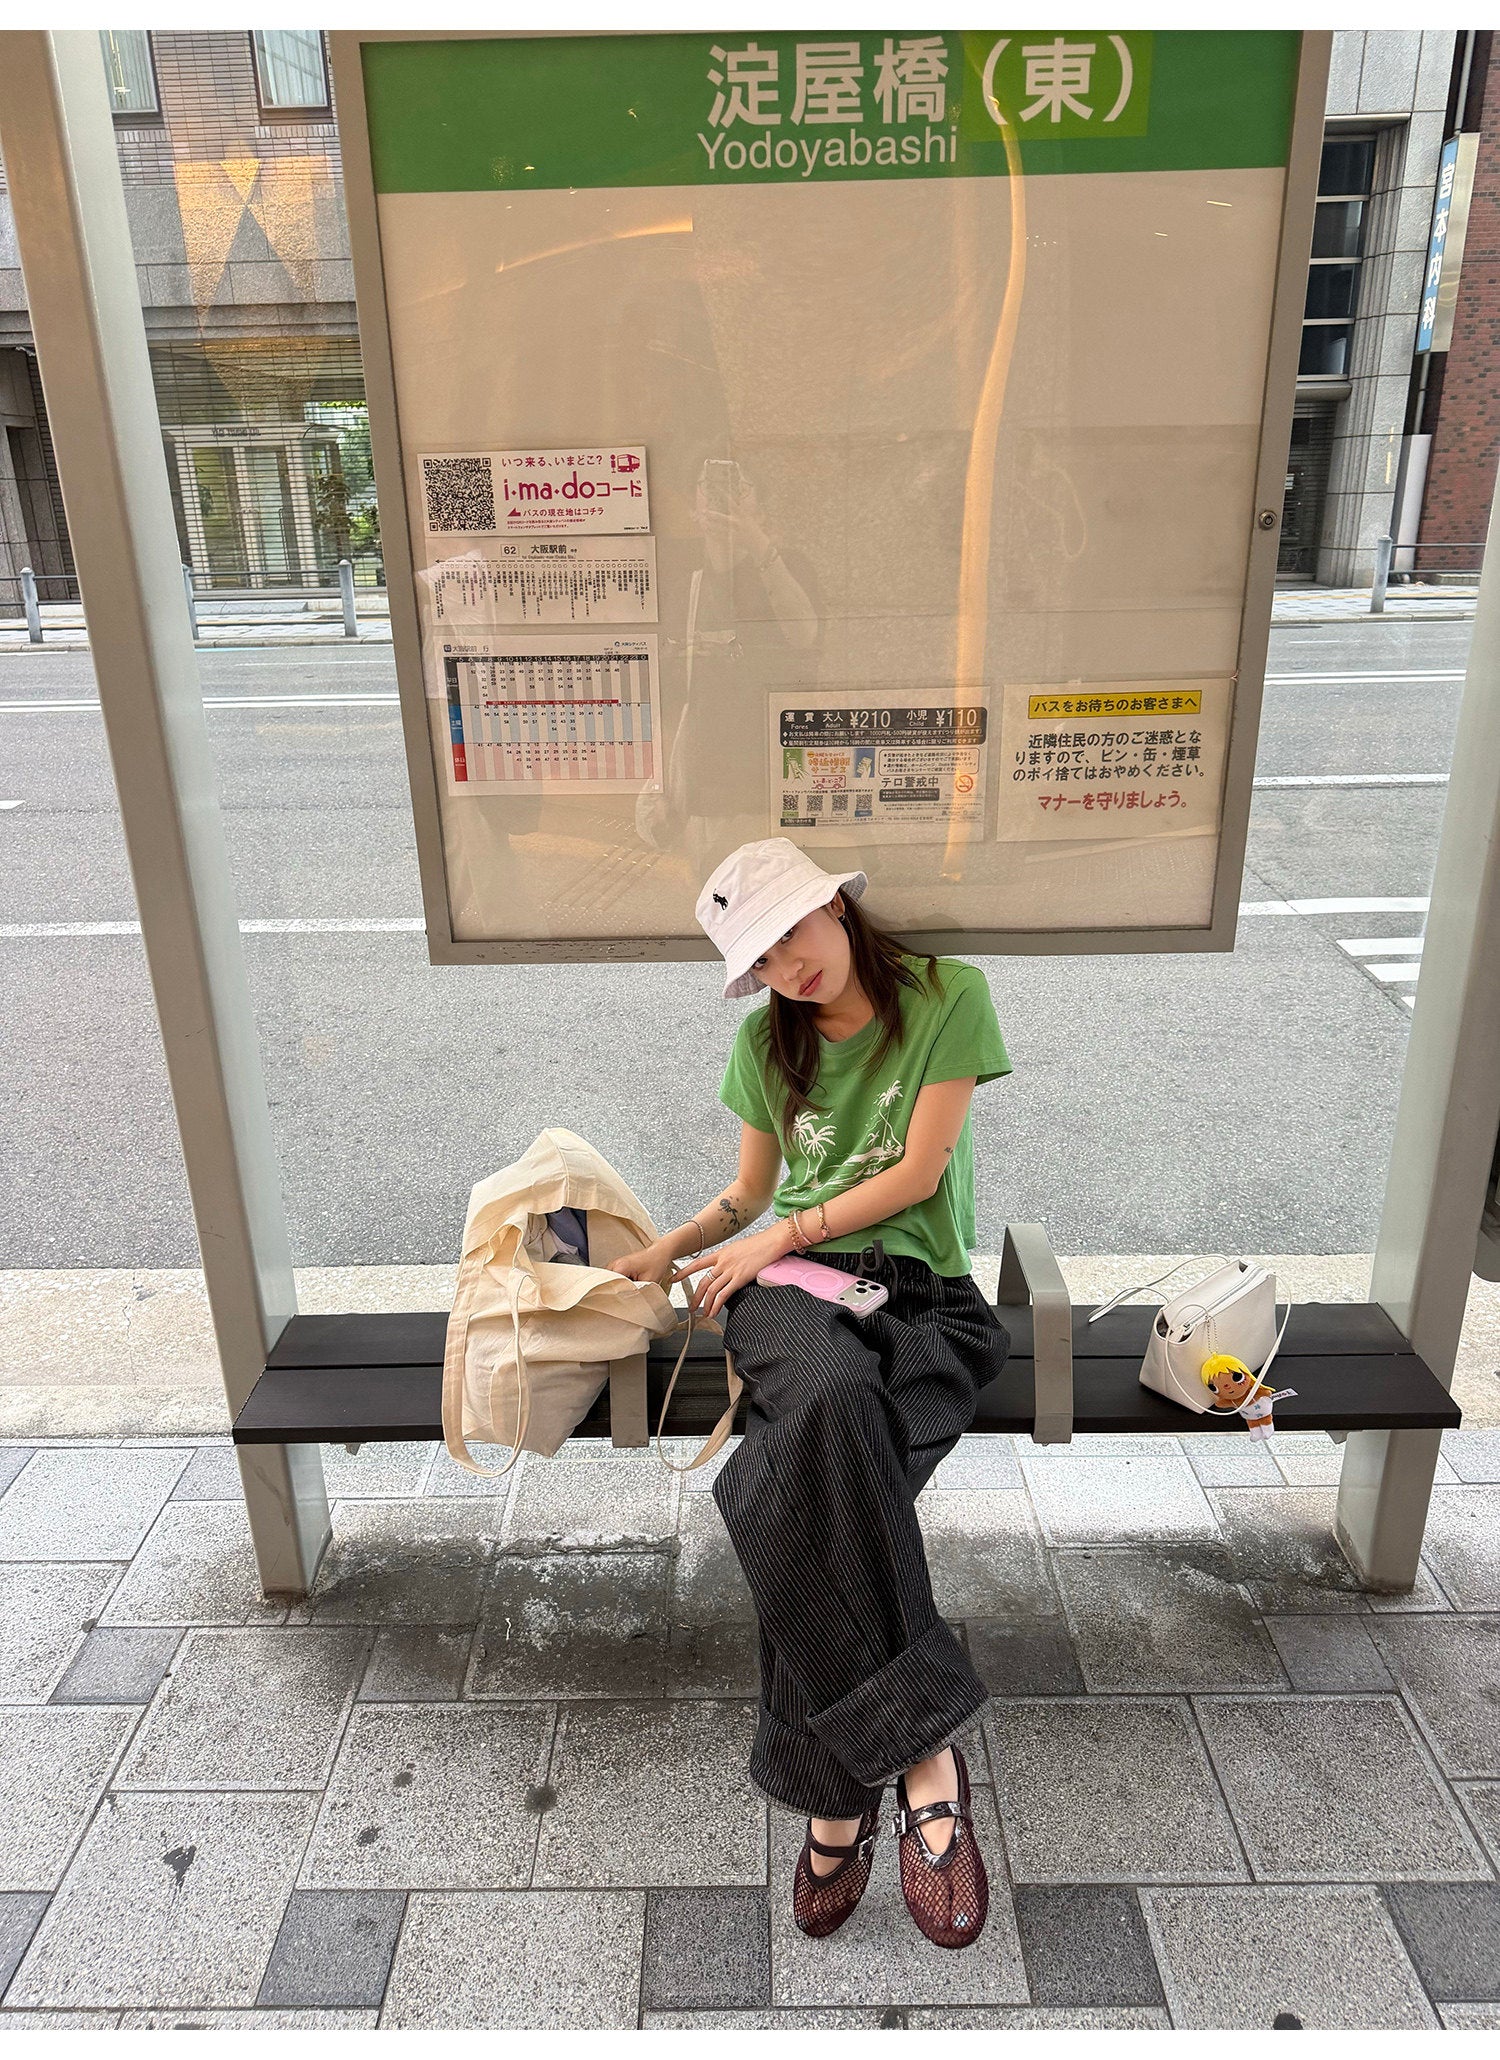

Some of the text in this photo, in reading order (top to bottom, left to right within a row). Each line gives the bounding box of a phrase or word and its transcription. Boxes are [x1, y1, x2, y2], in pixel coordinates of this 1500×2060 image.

[697, 125, 958, 177] Yodoyabashi
[1423, 162, 1455, 330] 宮本内科
[523, 507, 604, 517] バスの現在地はコチラ
[504, 546, 516, 554] 62
[531, 544, 567, 554] 大阪駅前
[1034, 696, 1198, 713] バスをお待ちのお客さまへ
[822, 712, 844, 722] 大人
[850, 710, 891, 728] ¥210
[906, 710, 928, 720] 小児
[936, 709, 977, 727] ¥110
[1028, 730, 1202, 750] 近隣住民の方のご迷惑とな
[881, 776, 939, 787] テロ警戒中
[1013, 764, 1205, 782] のポイ捨てはおやめください。
[1038, 790, 1187, 811] マナーを守りましょう。
